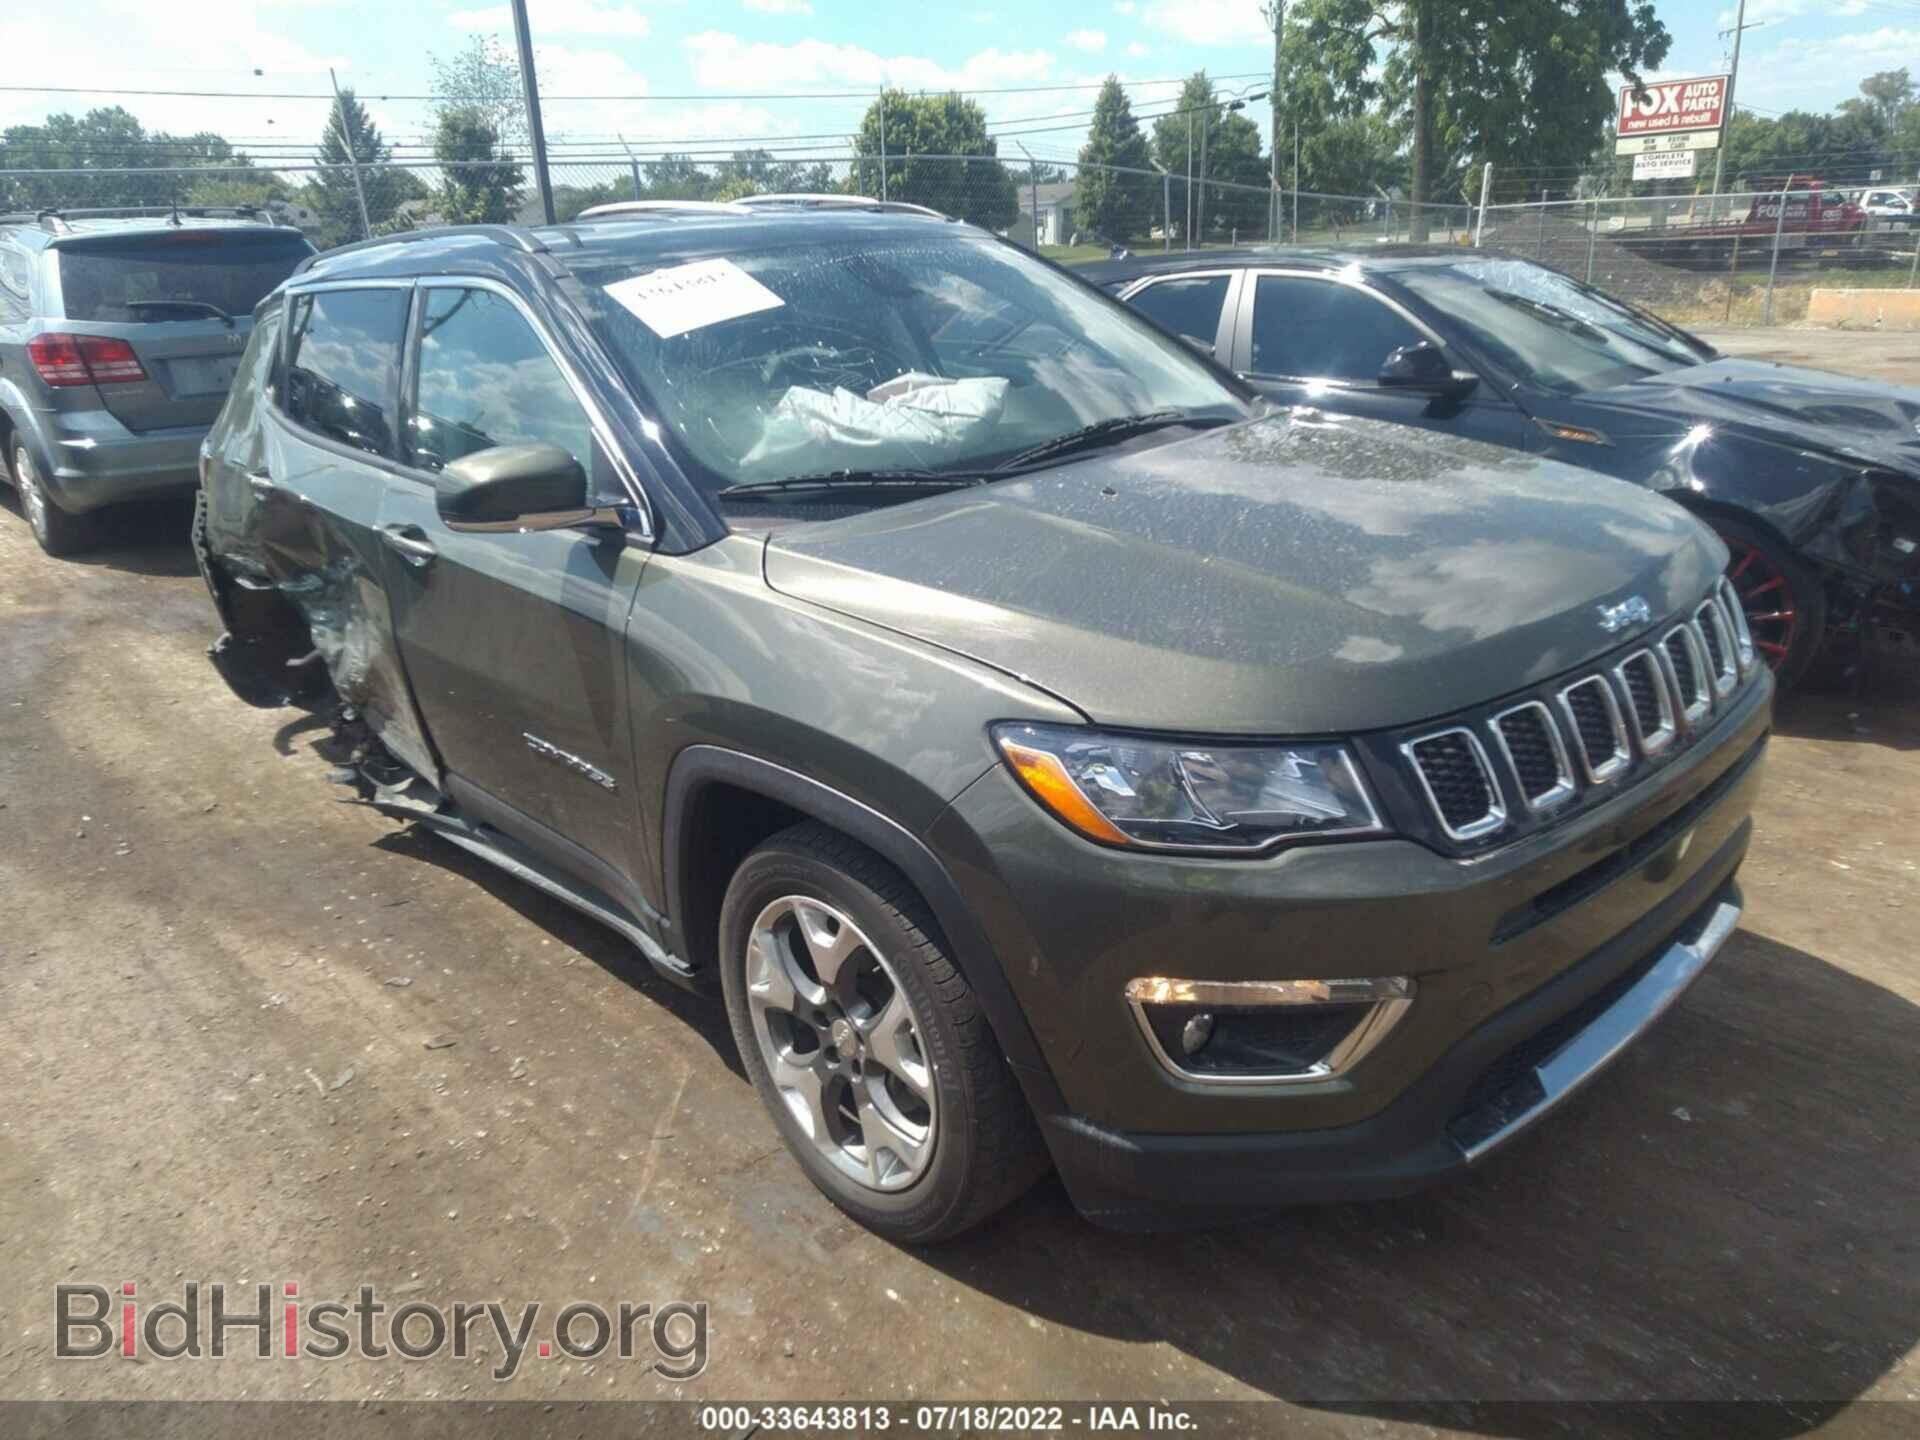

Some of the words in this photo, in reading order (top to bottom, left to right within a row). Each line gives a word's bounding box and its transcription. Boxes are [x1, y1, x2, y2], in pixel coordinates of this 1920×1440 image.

[1684, 81, 1718, 98] AUTO
[1681, 96, 1720, 112] PARTS
[1627, 119, 1648, 129] new
[1648, 115, 1671, 128] used
[1671, 114, 1680, 126] &
[1660, 159, 1692, 167] SERVICE
